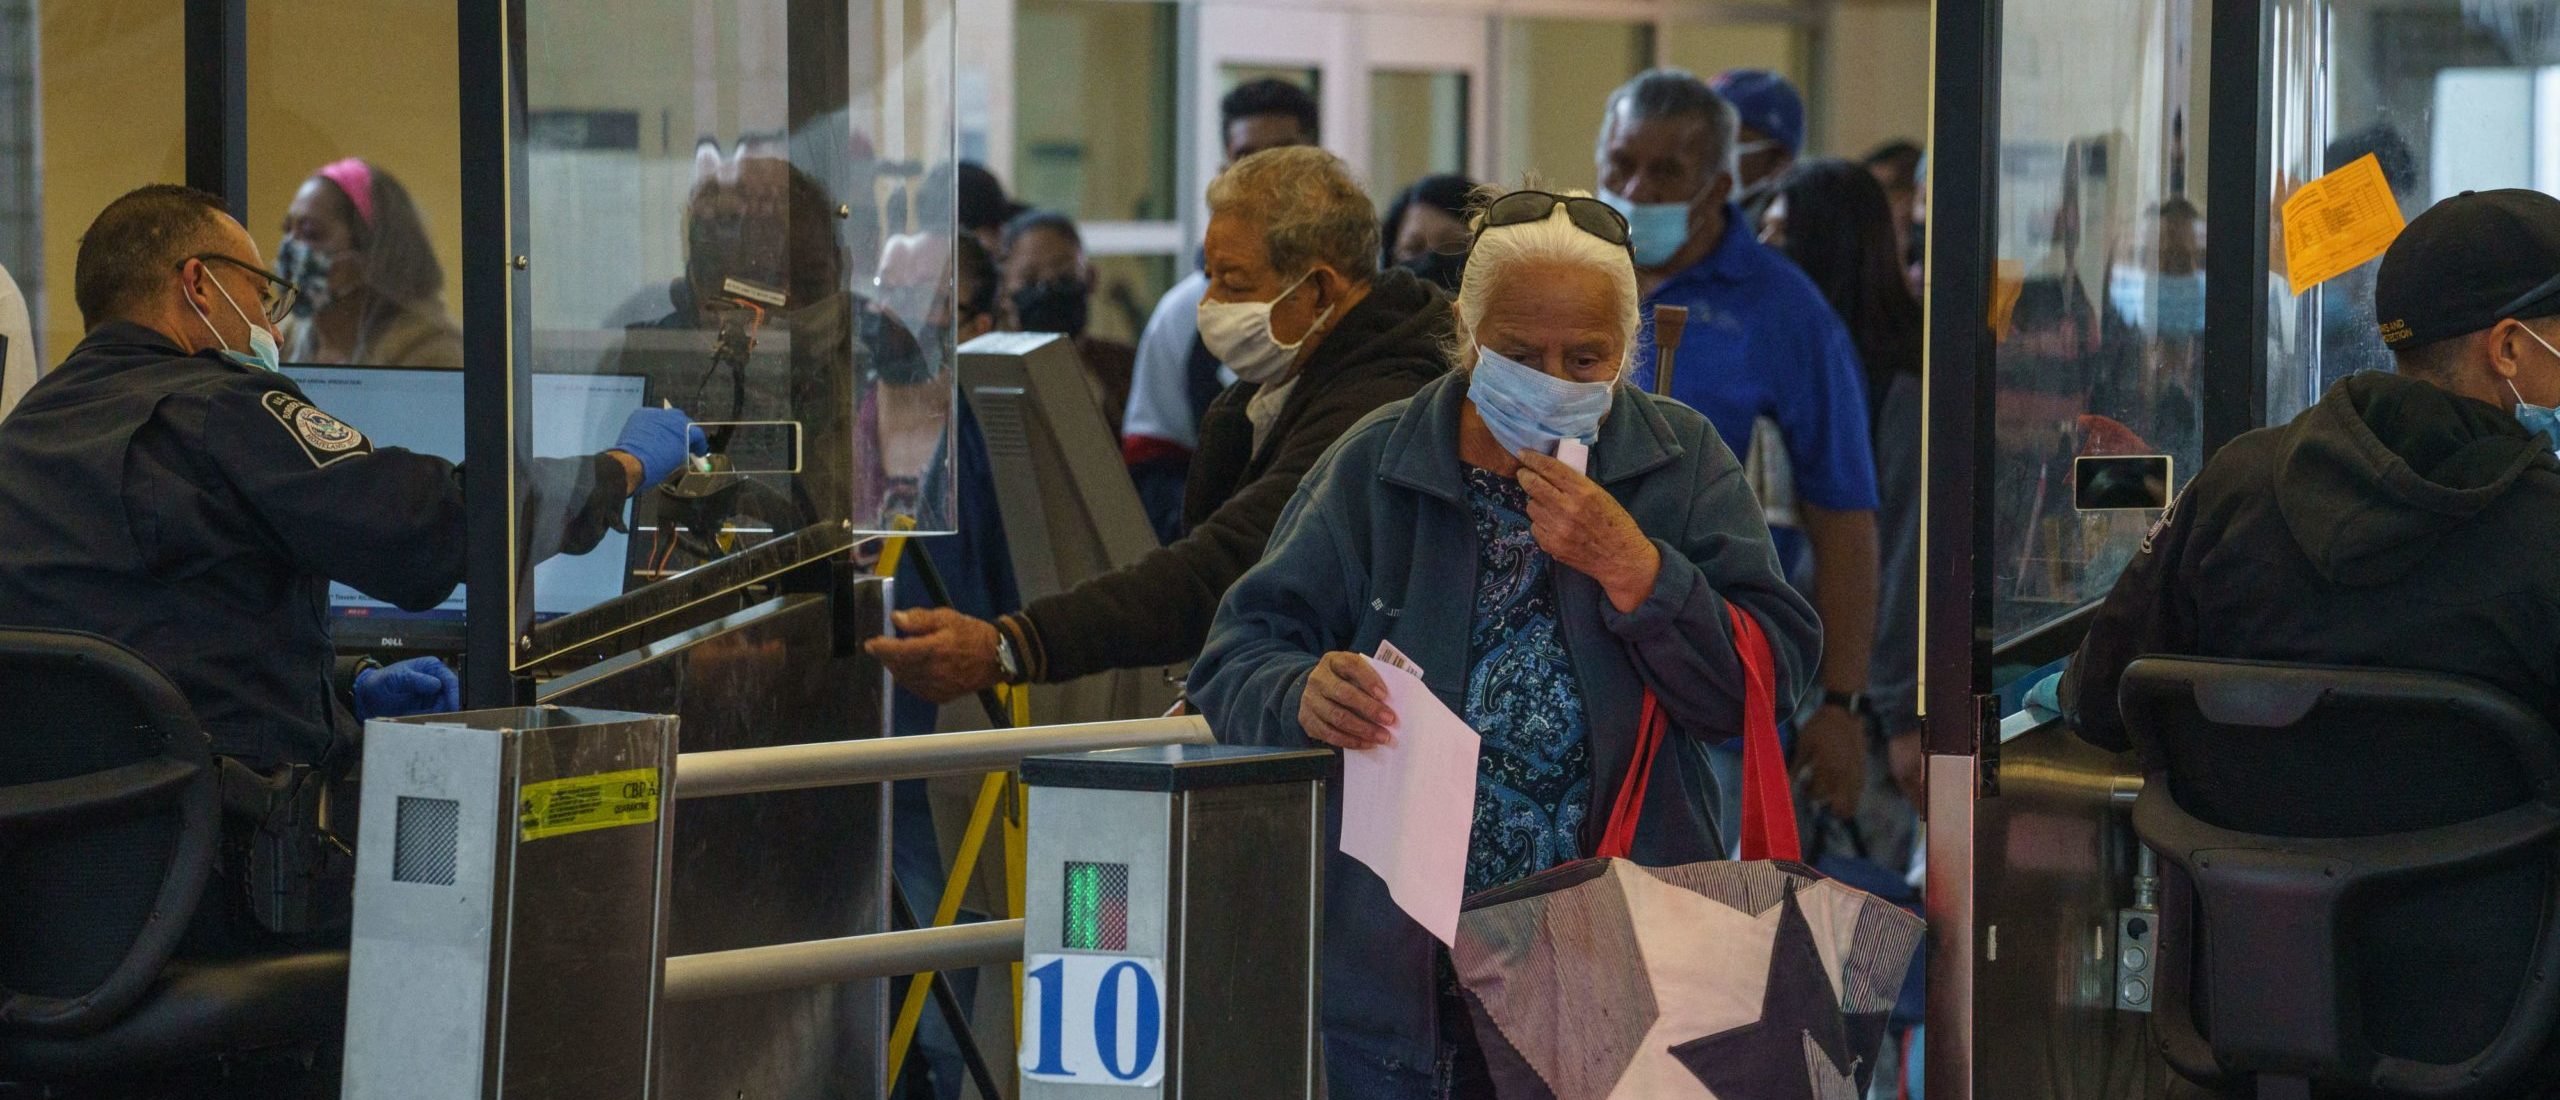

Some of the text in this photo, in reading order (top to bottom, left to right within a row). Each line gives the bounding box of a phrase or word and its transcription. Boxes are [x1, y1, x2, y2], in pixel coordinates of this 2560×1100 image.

[305, 434, 347, 449] HOMELAND
[381, 638, 403, 647] DELL
[622, 781, 646, 799] CBP
[1024, 957, 1161, 1081] 10
